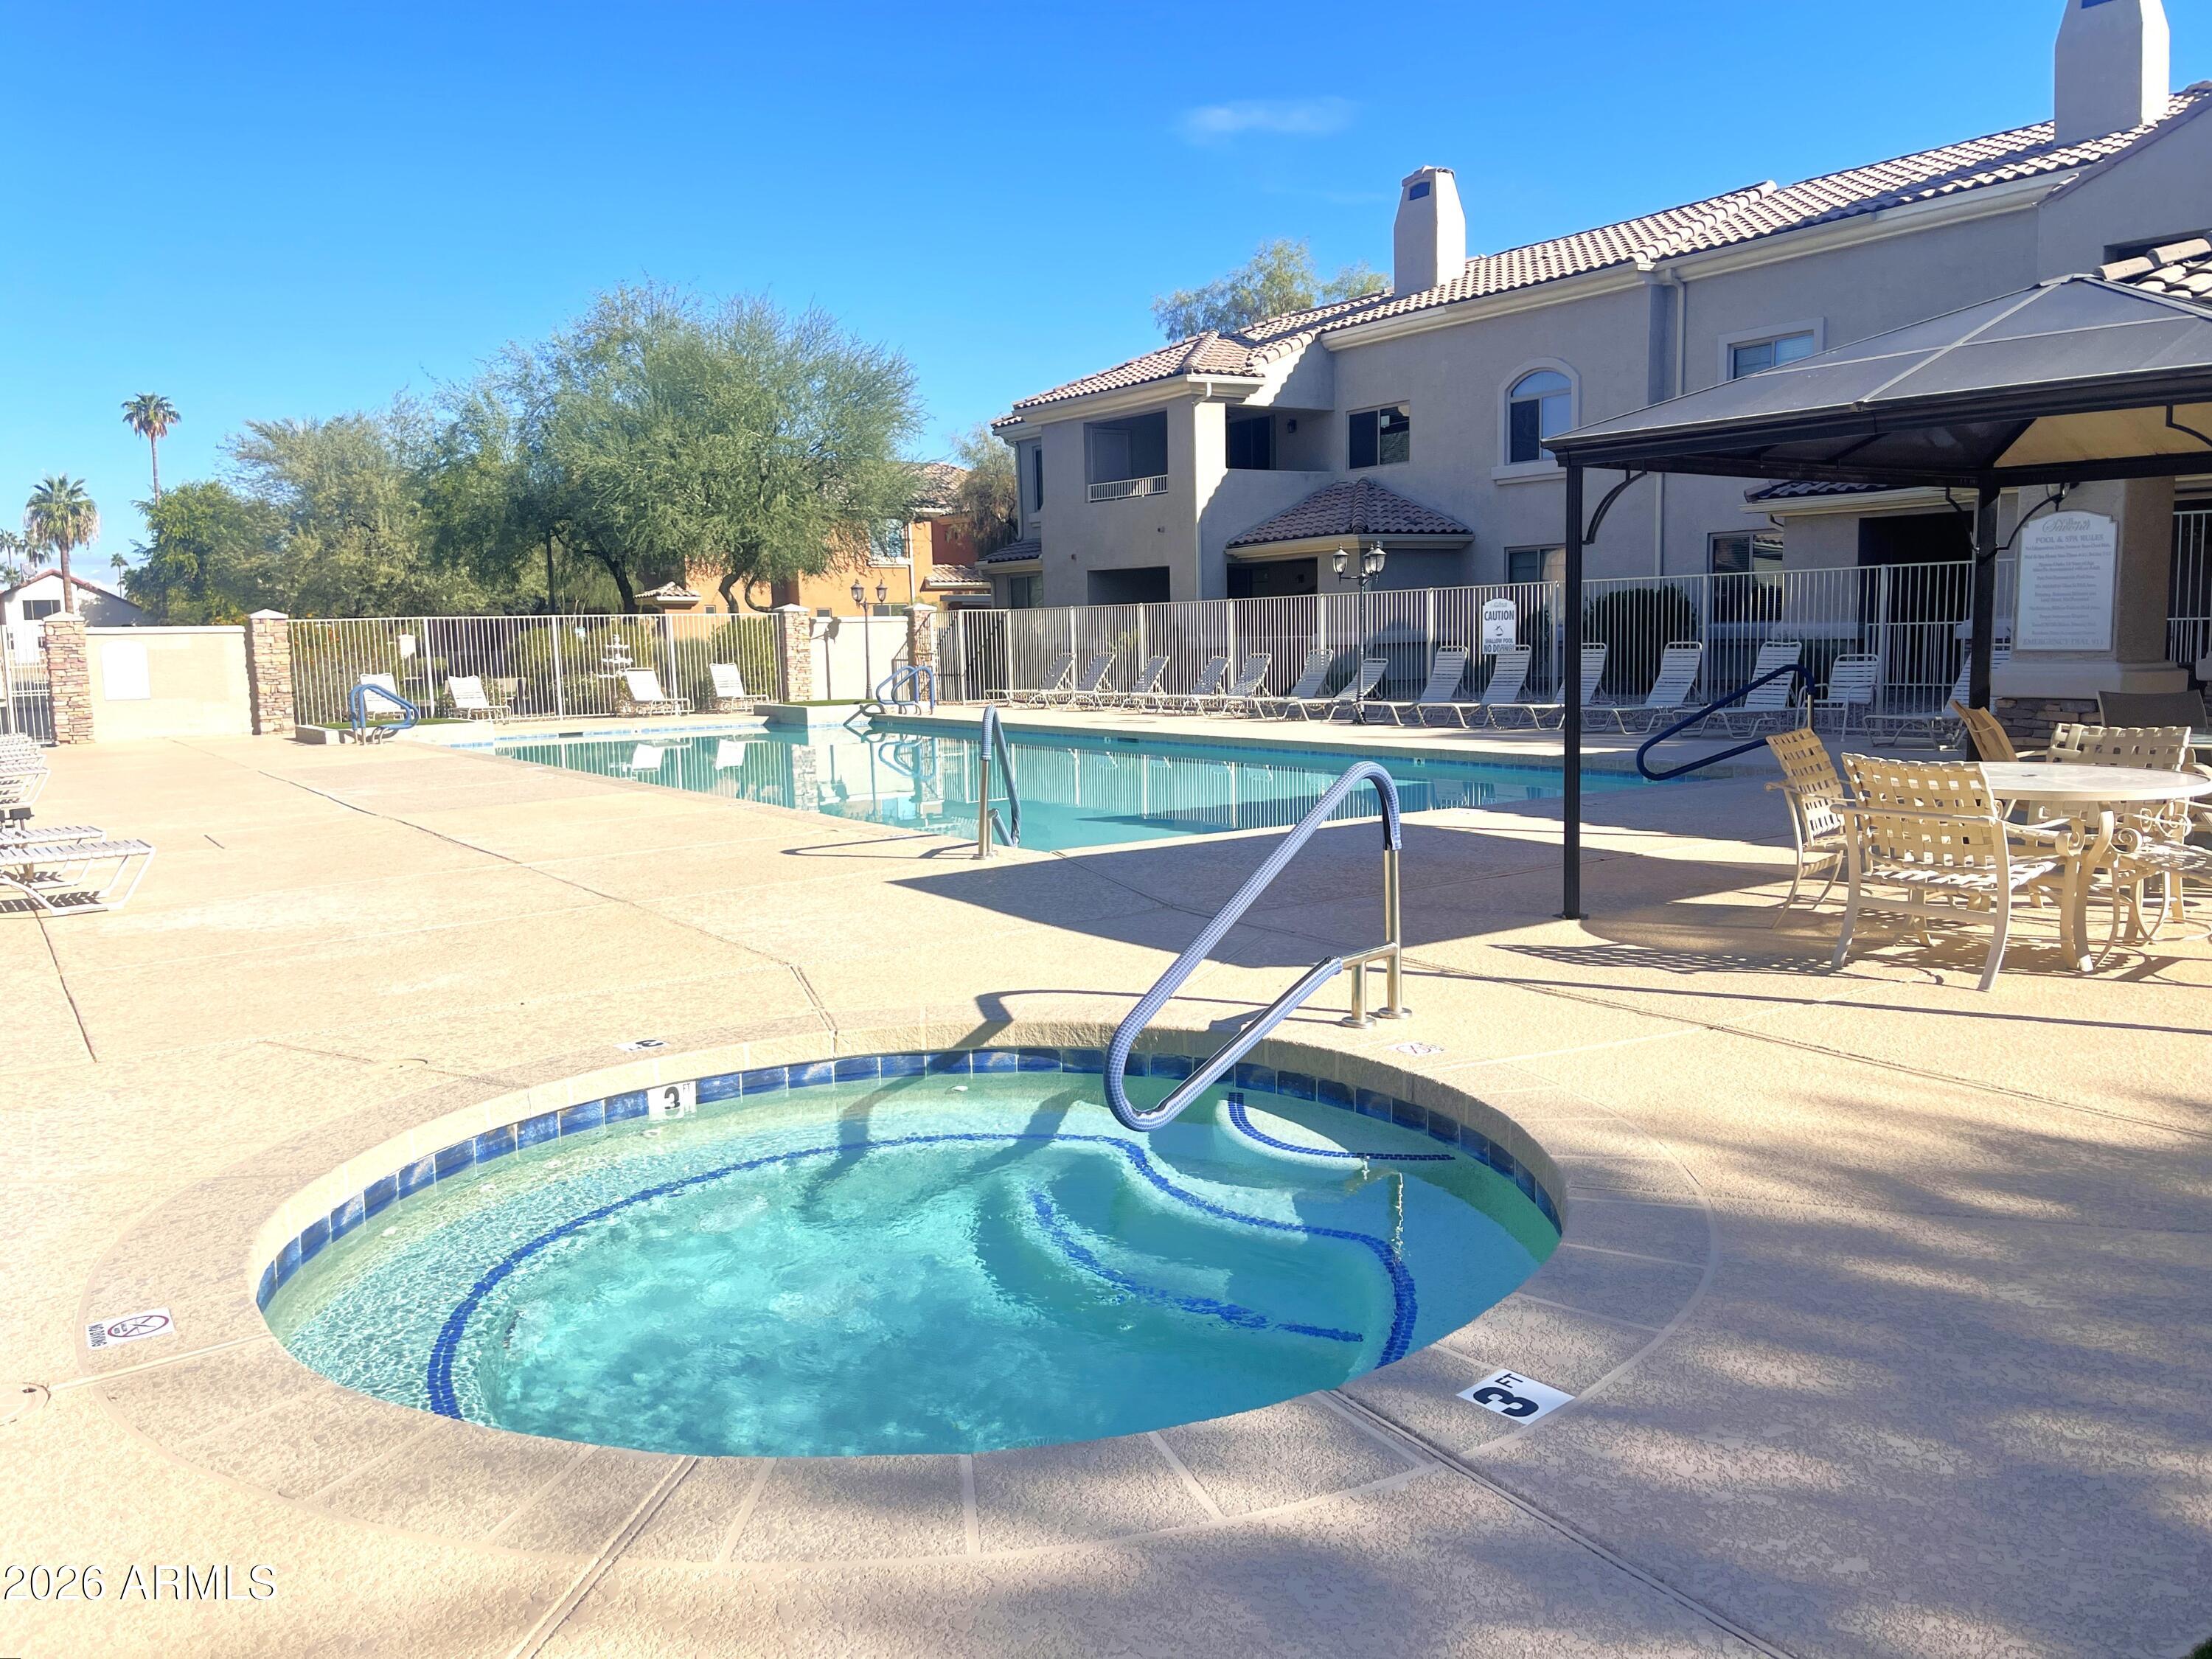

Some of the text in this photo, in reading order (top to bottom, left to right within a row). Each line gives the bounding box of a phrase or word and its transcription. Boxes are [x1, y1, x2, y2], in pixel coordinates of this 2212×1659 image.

[1484, 610, 1514, 621] CAUTION
[1484, 644, 1492, 653] NO
[1473, 1373, 1539, 1417] 3 FT
